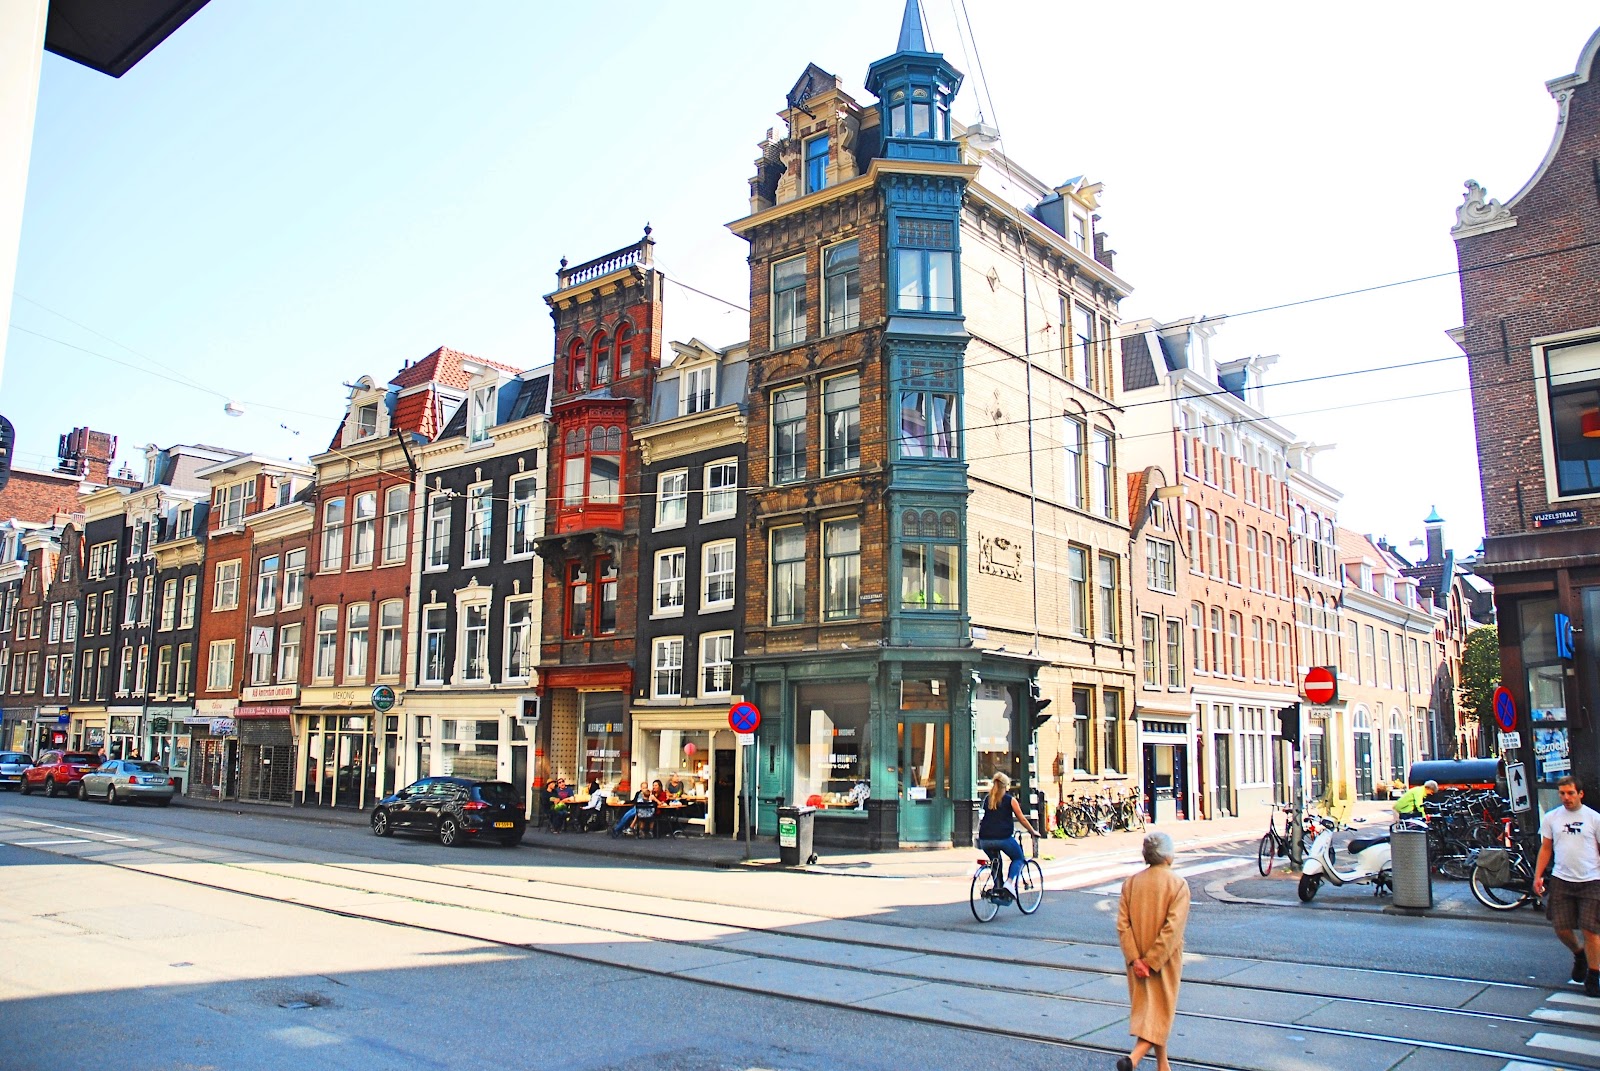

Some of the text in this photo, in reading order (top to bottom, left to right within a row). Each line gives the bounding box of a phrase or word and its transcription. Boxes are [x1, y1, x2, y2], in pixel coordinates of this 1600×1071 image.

[1535, 510, 1578, 521] VIJZELSTRAAT
[333, 691, 354, 699] MEKONG
[1536, 738, 1570, 754] Gezocht
